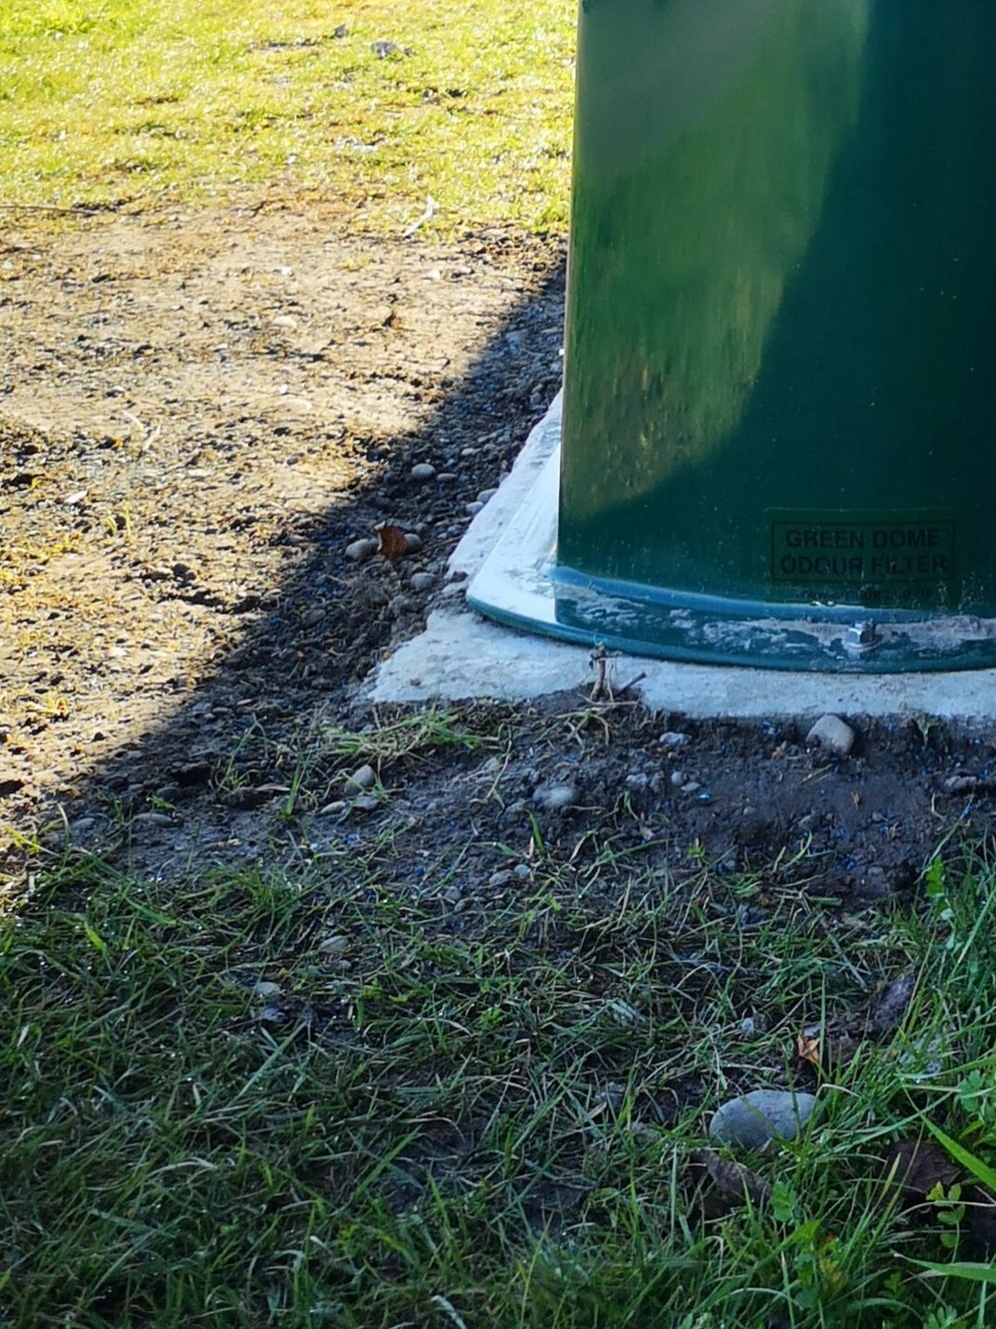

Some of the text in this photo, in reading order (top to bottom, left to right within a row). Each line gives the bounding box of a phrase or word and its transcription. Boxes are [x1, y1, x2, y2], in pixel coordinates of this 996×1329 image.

[786, 528, 941, 548] GREEN DOME
[781, 554, 946, 575] ODOUR FILTER
